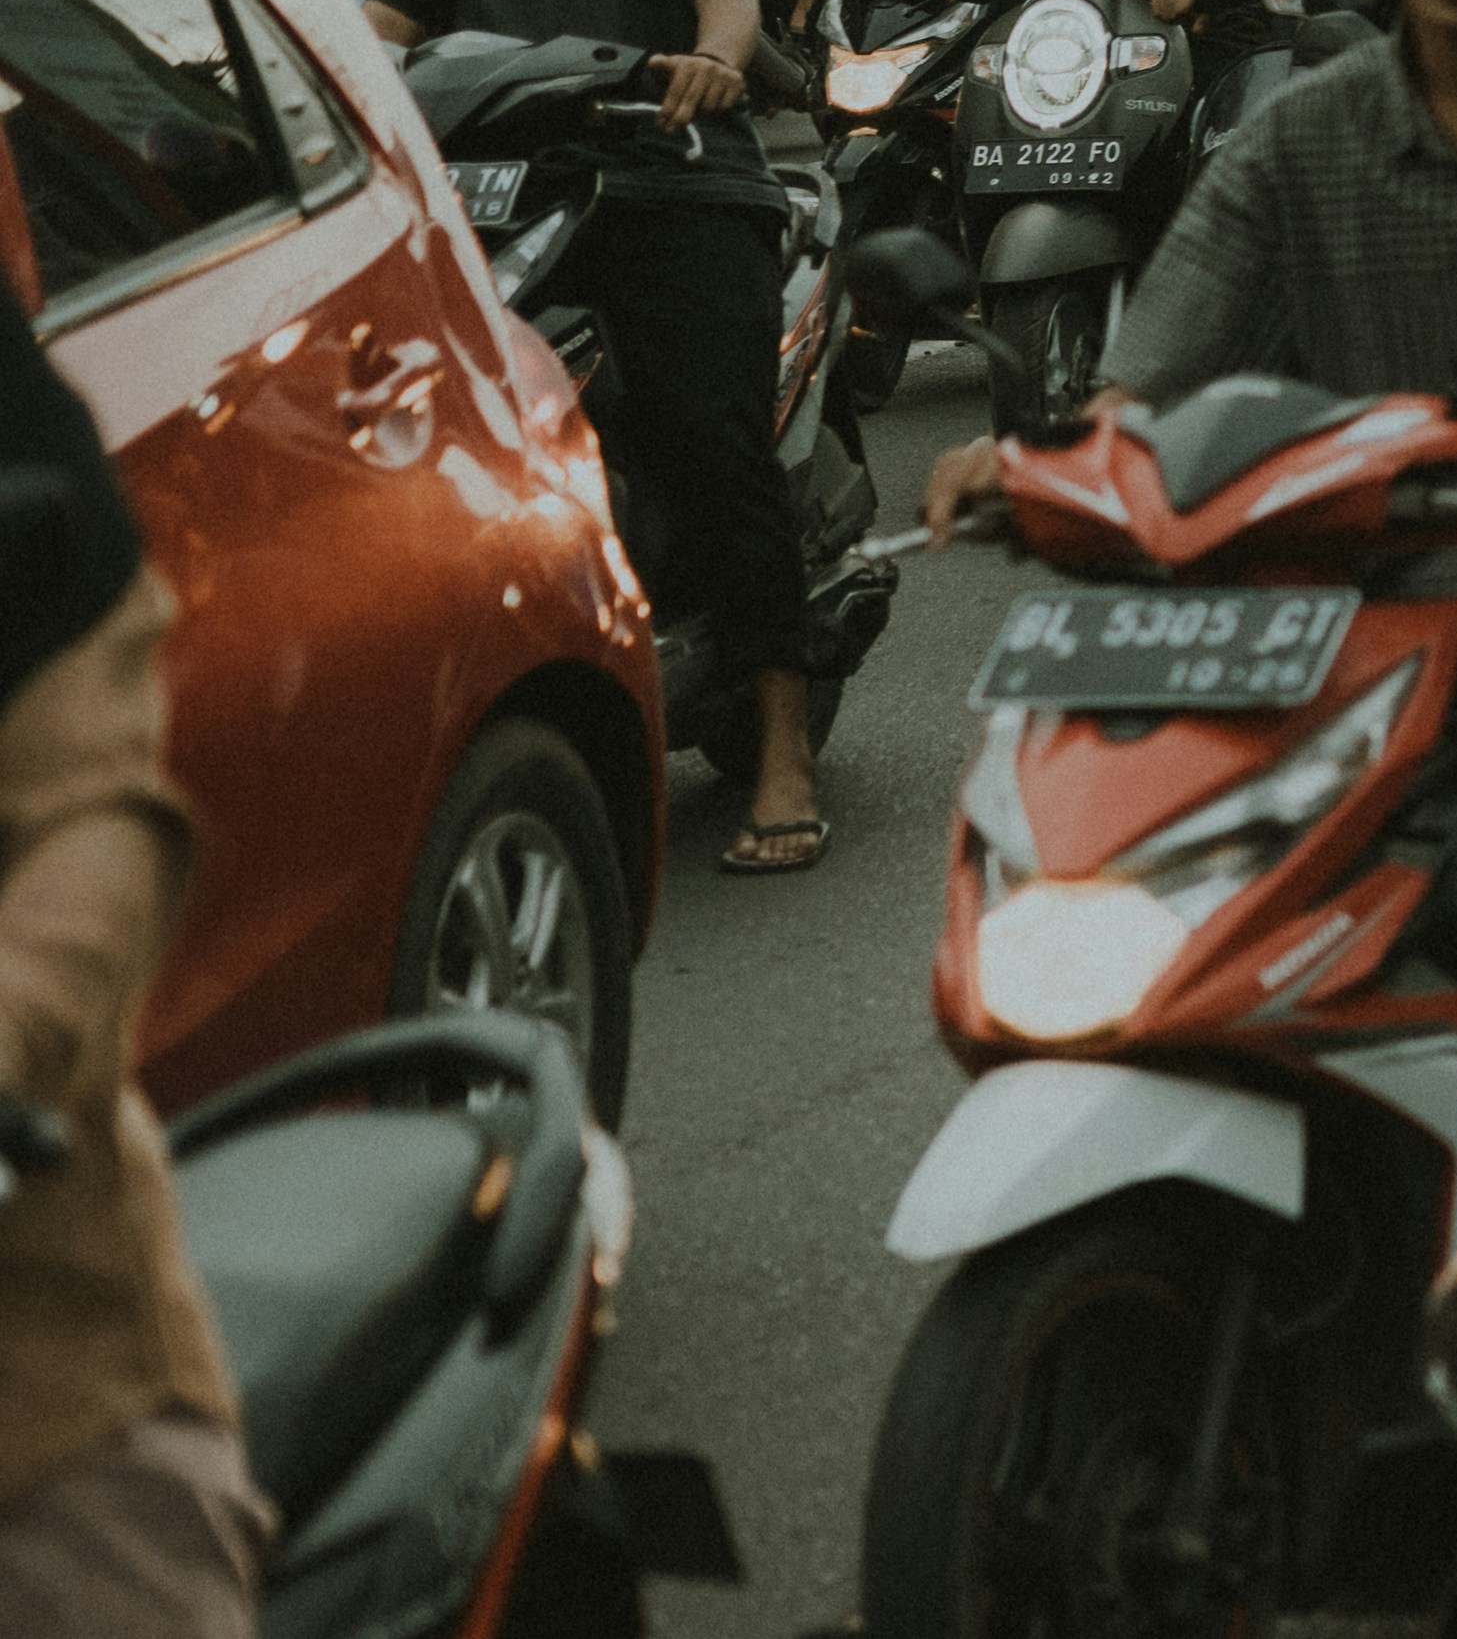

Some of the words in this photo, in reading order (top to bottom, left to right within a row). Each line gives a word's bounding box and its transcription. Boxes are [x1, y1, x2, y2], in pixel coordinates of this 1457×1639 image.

[1124, 99, 1178, 113] STYLISH
[972, 145, 1004, 167] BA
[1016, 142, 1076, 166] 2122
[1088, 141, 1121, 163] FO
[477, 168, 519, 193] TN
